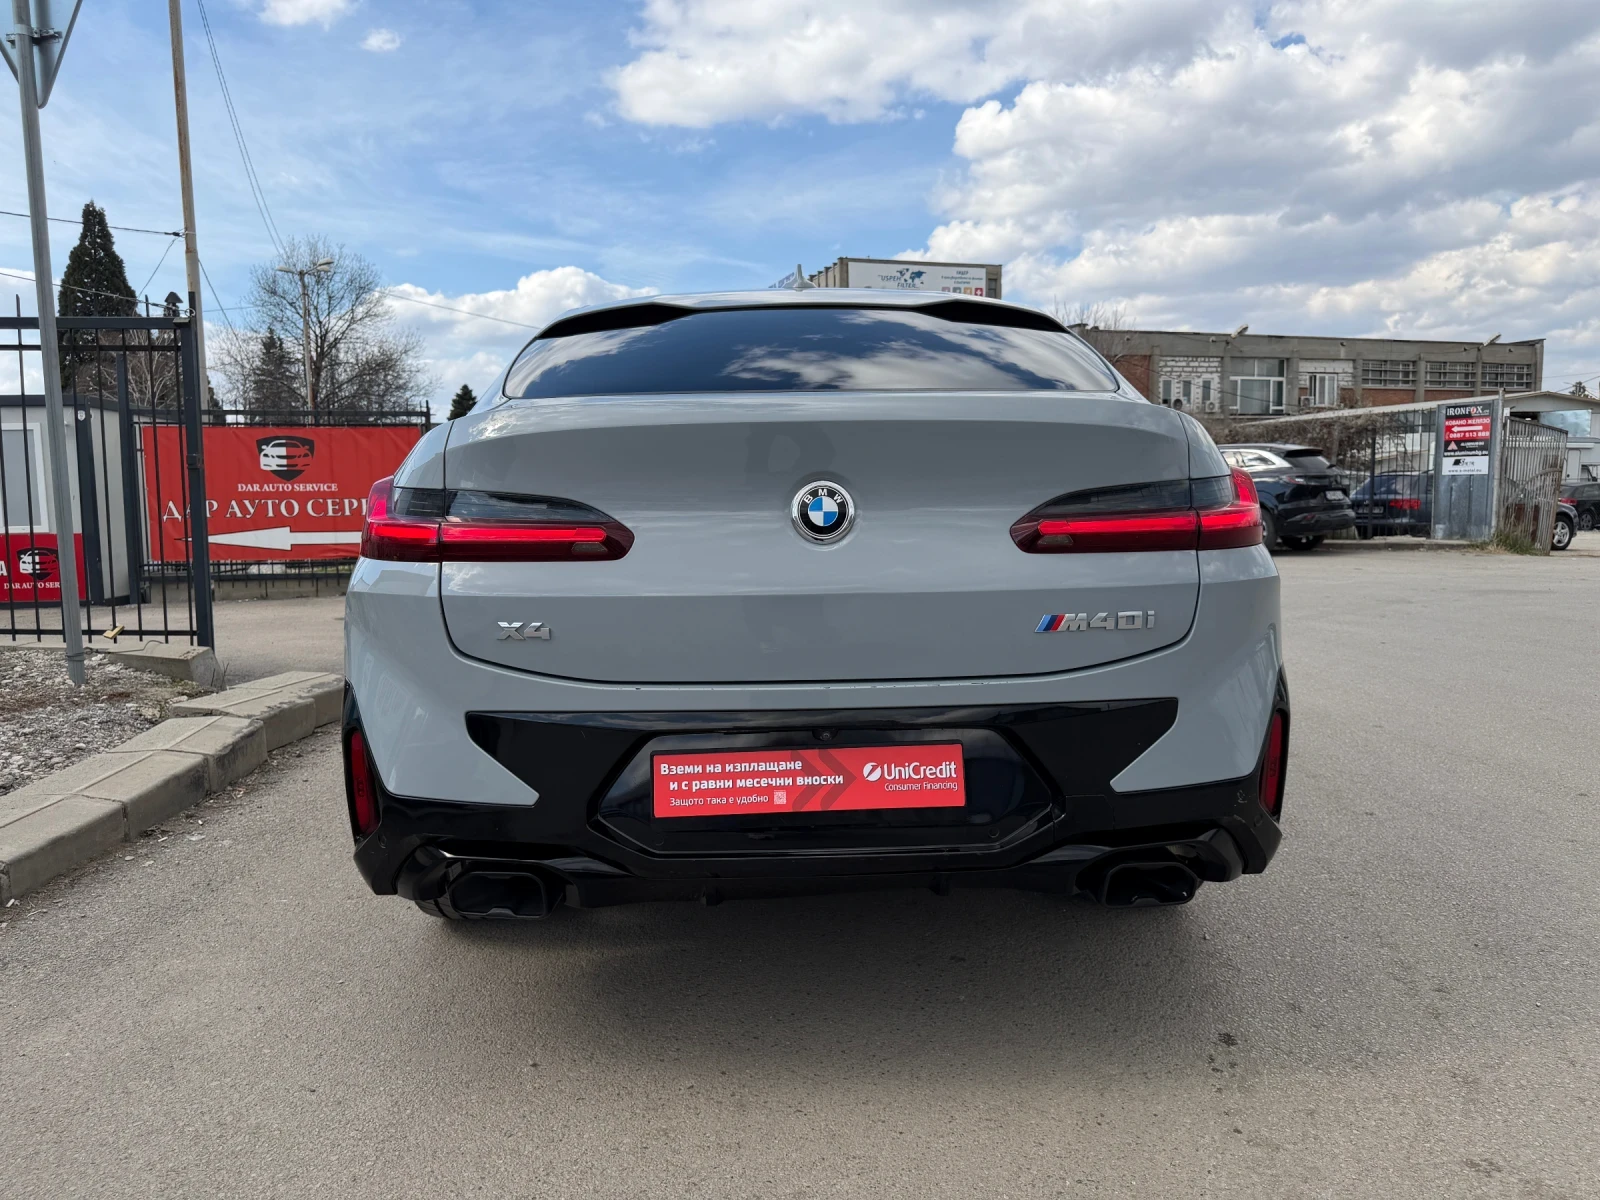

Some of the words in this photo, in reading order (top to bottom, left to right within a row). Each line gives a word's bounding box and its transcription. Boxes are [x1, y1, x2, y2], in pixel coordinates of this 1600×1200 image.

[1447, 406, 1482, 415] IRONFOX
[237, 483, 260, 492] DAR
[262, 483, 292, 492] AUTO
[293, 483, 339, 492] SERVICE
[803, 488, 843, 504] BMW
[225, 498, 300, 519] АУТО
[1057, 610, 1155, 632] M40i
[497, 621, 551, 640] X4
[660, 763, 702, 775] Вземи
[706, 763, 722, 773] на
[725, 760, 803, 773] изплащане
[883, 761, 957, 780] UniCredit
[669, 781, 678, 791] и
[681, 781, 689, 790] с
[692, 779, 733, 792] равни
[736, 776, 793, 788] месечни
[796, 775, 844, 786] вноски
[884, 782, 921, 791] Consumer
[923, 781, 958, 792] Financing
[669, 797, 704, 807] Защото
[706, 796, 727, 805] така
[736, 794, 769, 805] удобно
